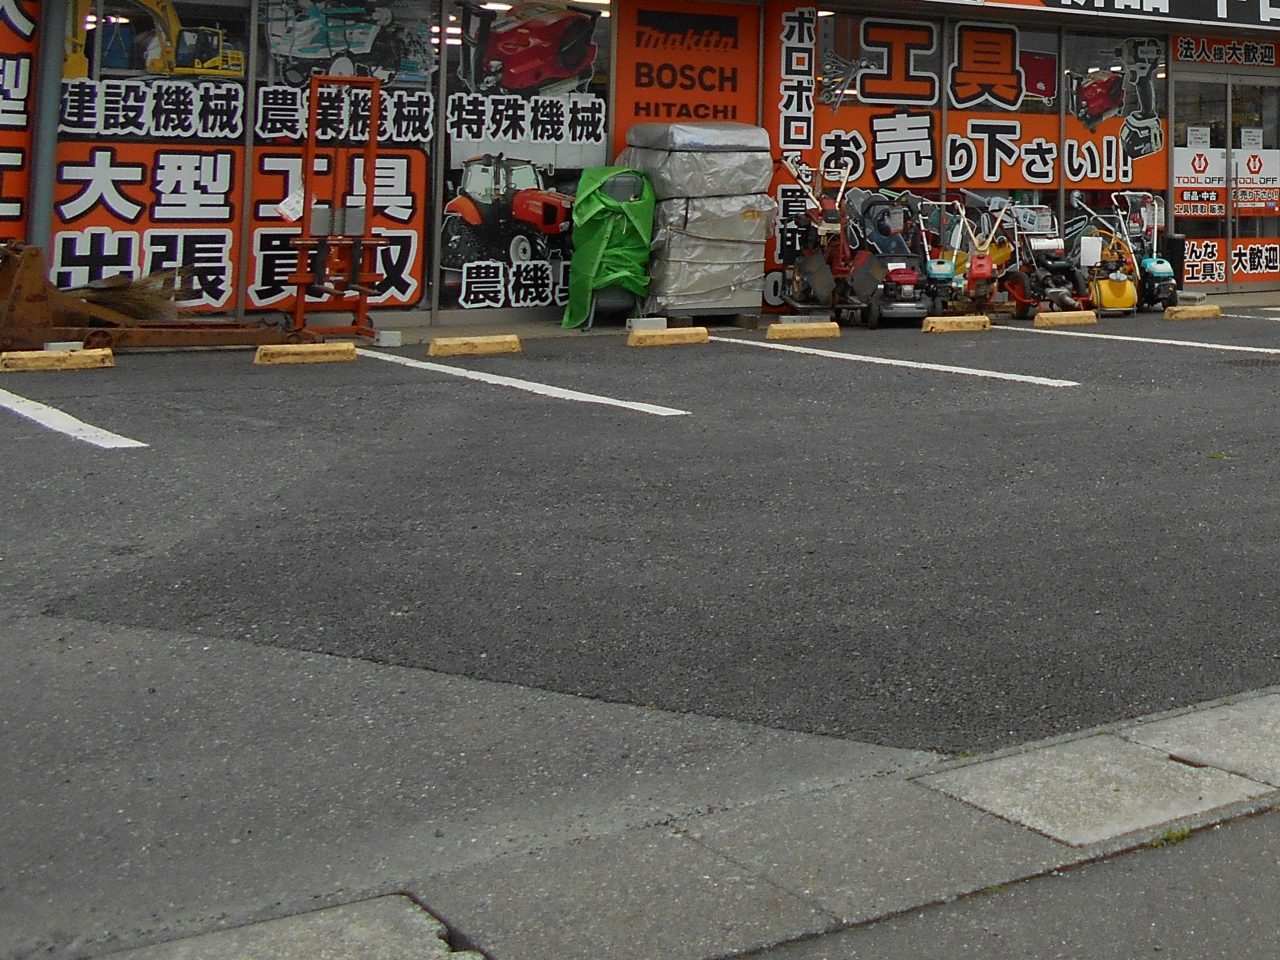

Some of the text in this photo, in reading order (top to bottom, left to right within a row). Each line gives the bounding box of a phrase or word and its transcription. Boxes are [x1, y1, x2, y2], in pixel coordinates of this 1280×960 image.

[858, 18, 1026, 110] 工具
[1178, 38, 1275, 65] 法人様大歓迎
[635, 61, 738, 92] BOSCH
[60, 79, 244, 138] 建設機械
[256, 86, 434, 142] 農業機械
[448, 93, 607, 144] 特殊機械
[634, 101, 737, 120] HITACHI
[57, 150, 414, 223] 大型工具
[1176, 176, 1225, 185] TOOL OFF
[1259, 177, 1278, 185] OFF
[1231, 244, 1280, 274] 大歓迎
[459, 260, 573, 309] 農機
